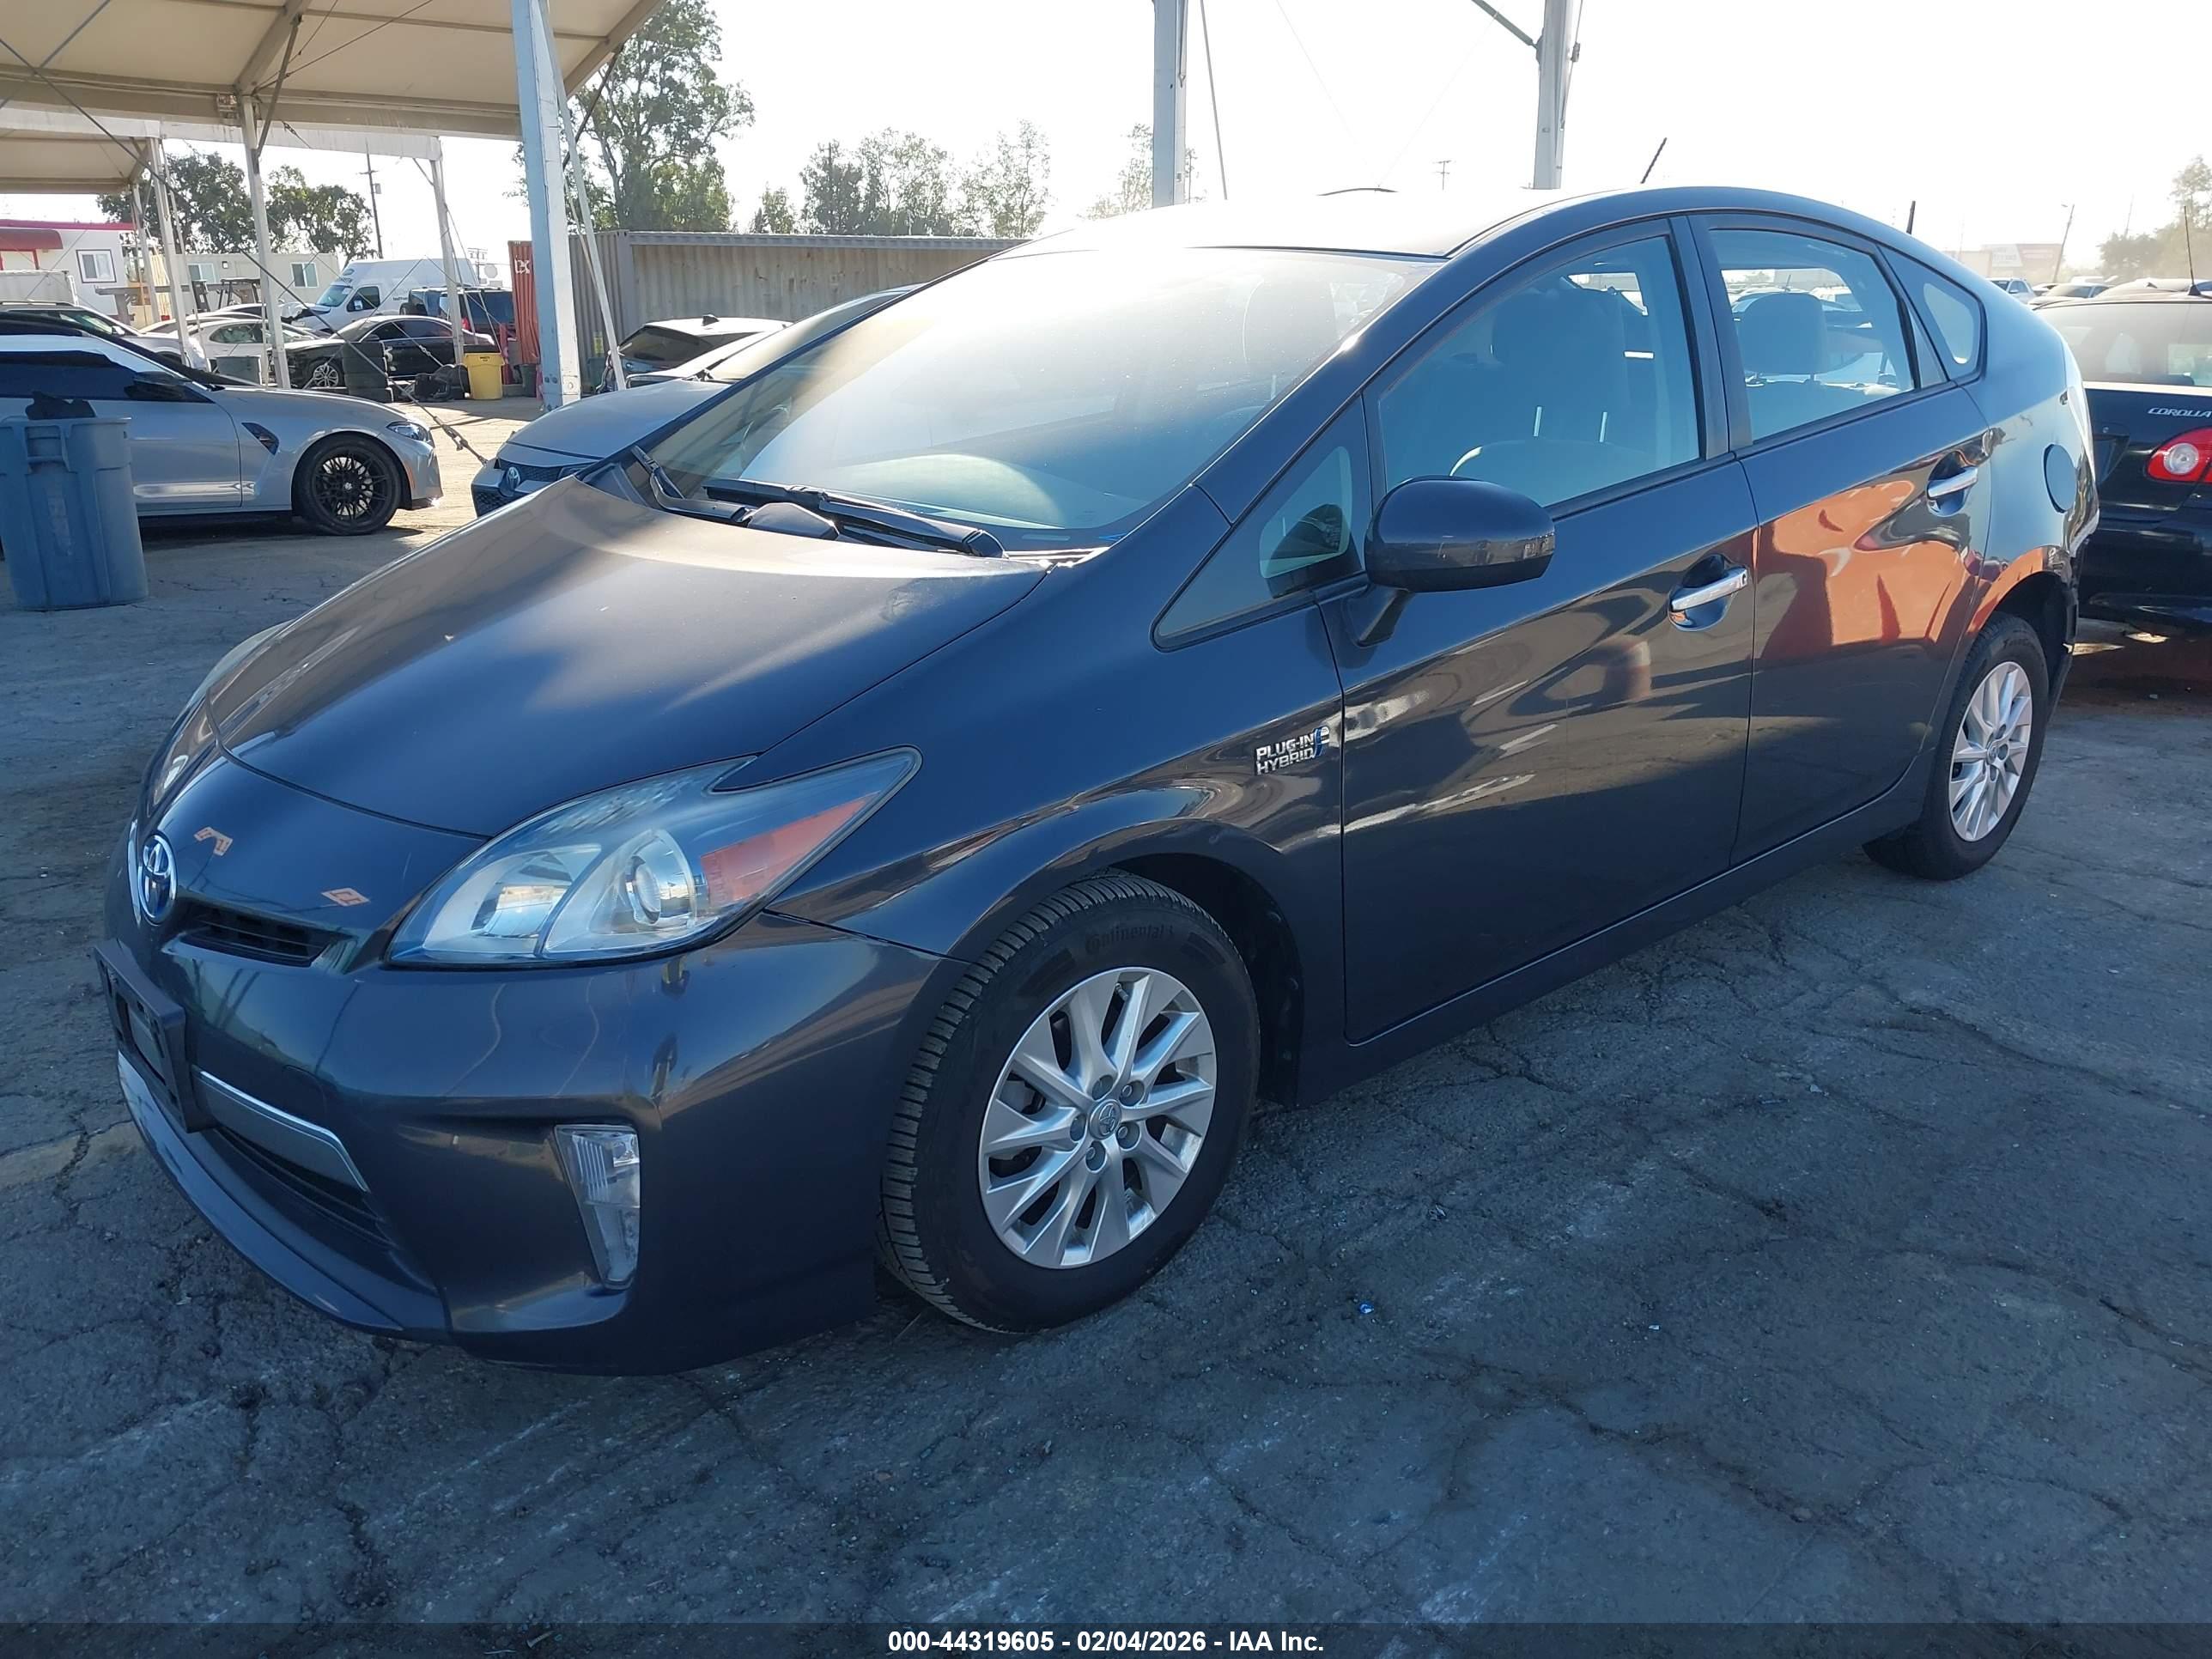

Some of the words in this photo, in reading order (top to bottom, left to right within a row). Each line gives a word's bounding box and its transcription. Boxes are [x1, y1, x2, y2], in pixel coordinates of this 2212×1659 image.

[2147, 406, 2212, 418] COROLLA
[1255, 732, 1315, 762] PLUG-IN
[1255, 747, 1316, 775] HYBRID
